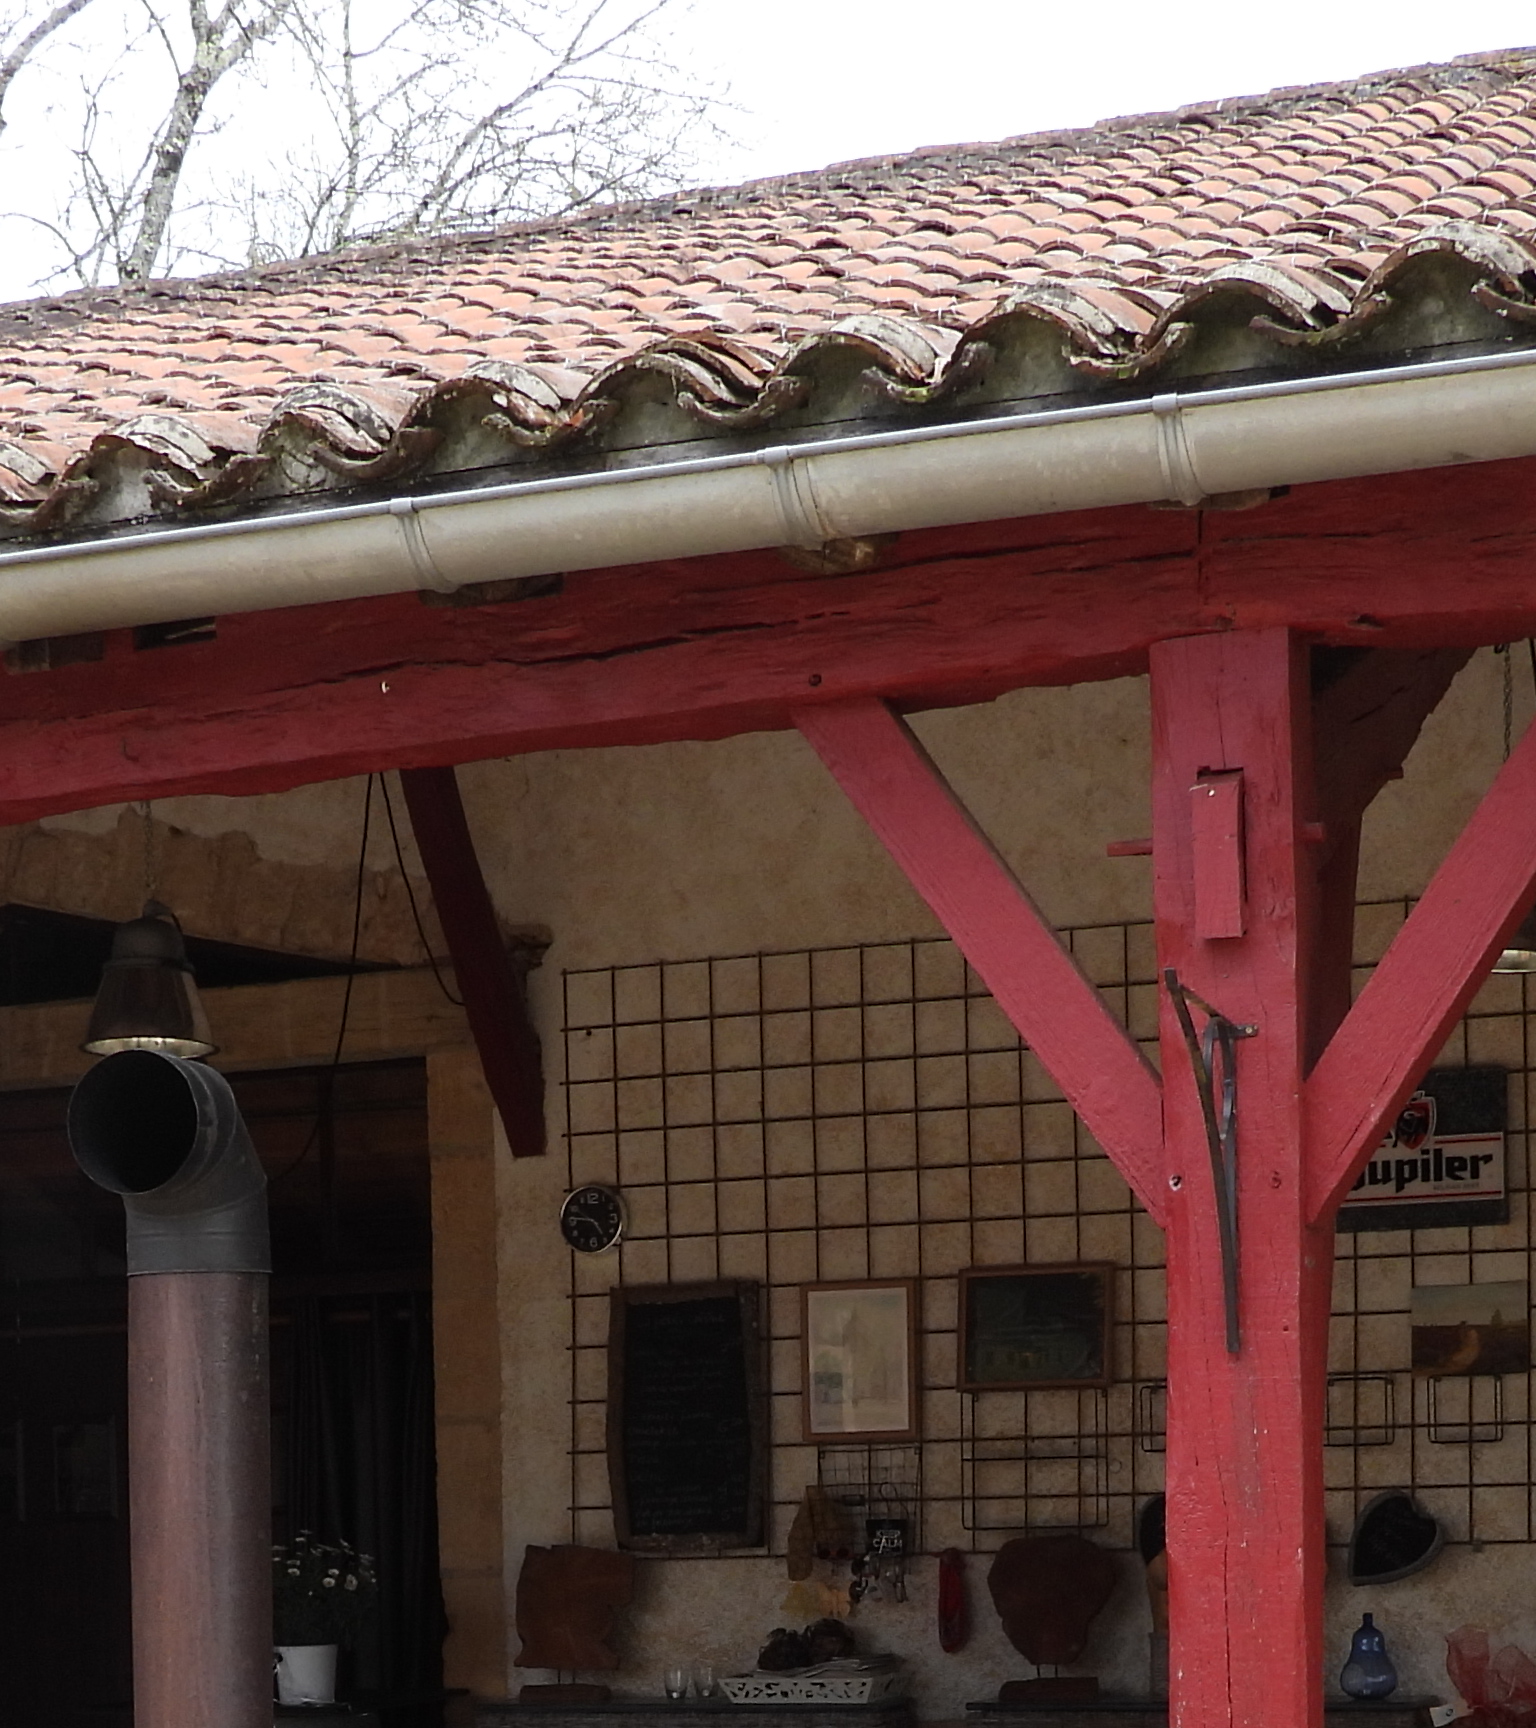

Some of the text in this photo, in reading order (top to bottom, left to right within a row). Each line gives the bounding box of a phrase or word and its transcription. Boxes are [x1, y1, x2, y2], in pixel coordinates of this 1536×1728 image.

[586, 1193, 599, 1204] 12
[609, 1213, 618, 1223] 3
[589, 1237, 598, 1248] 6
